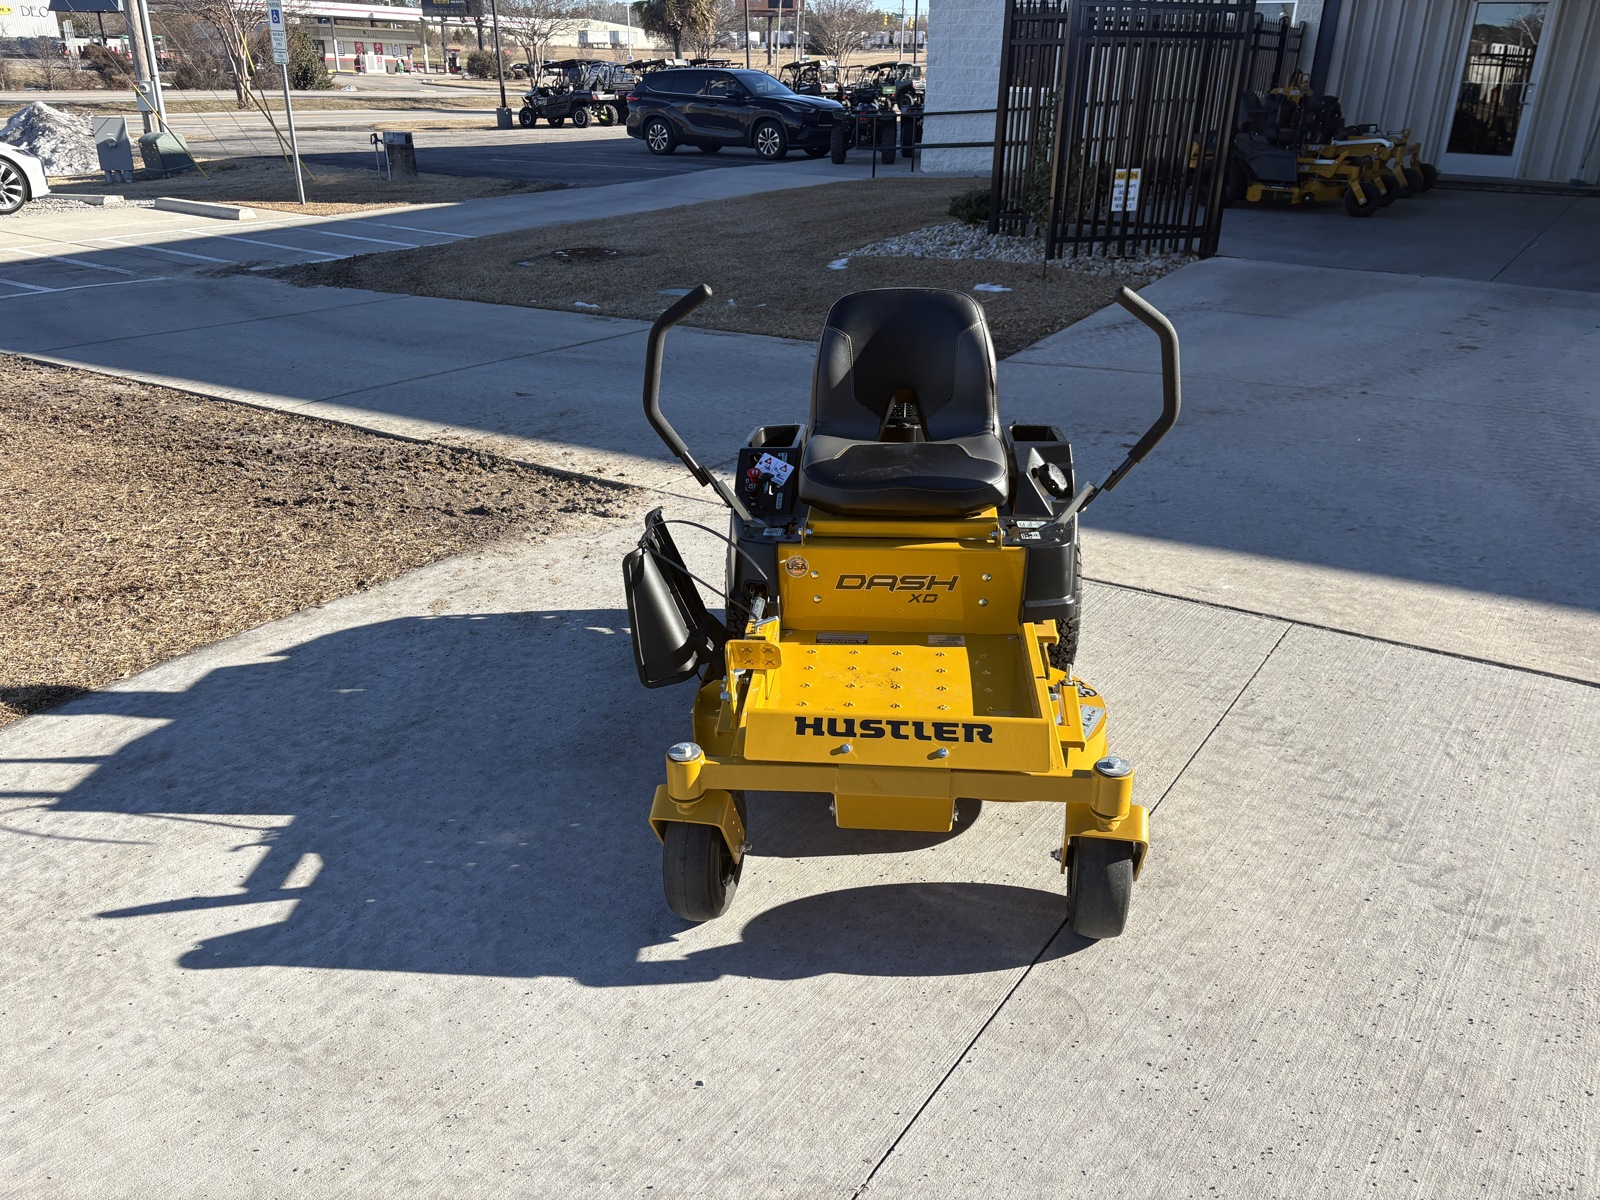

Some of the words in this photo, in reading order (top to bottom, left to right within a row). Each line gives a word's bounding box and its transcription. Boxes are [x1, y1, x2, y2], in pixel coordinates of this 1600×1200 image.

[786, 562, 808, 571] USA
[834, 574, 959, 592] DASH
[907, 593, 939, 604] XD
[794, 716, 993, 744] HUSTLER
